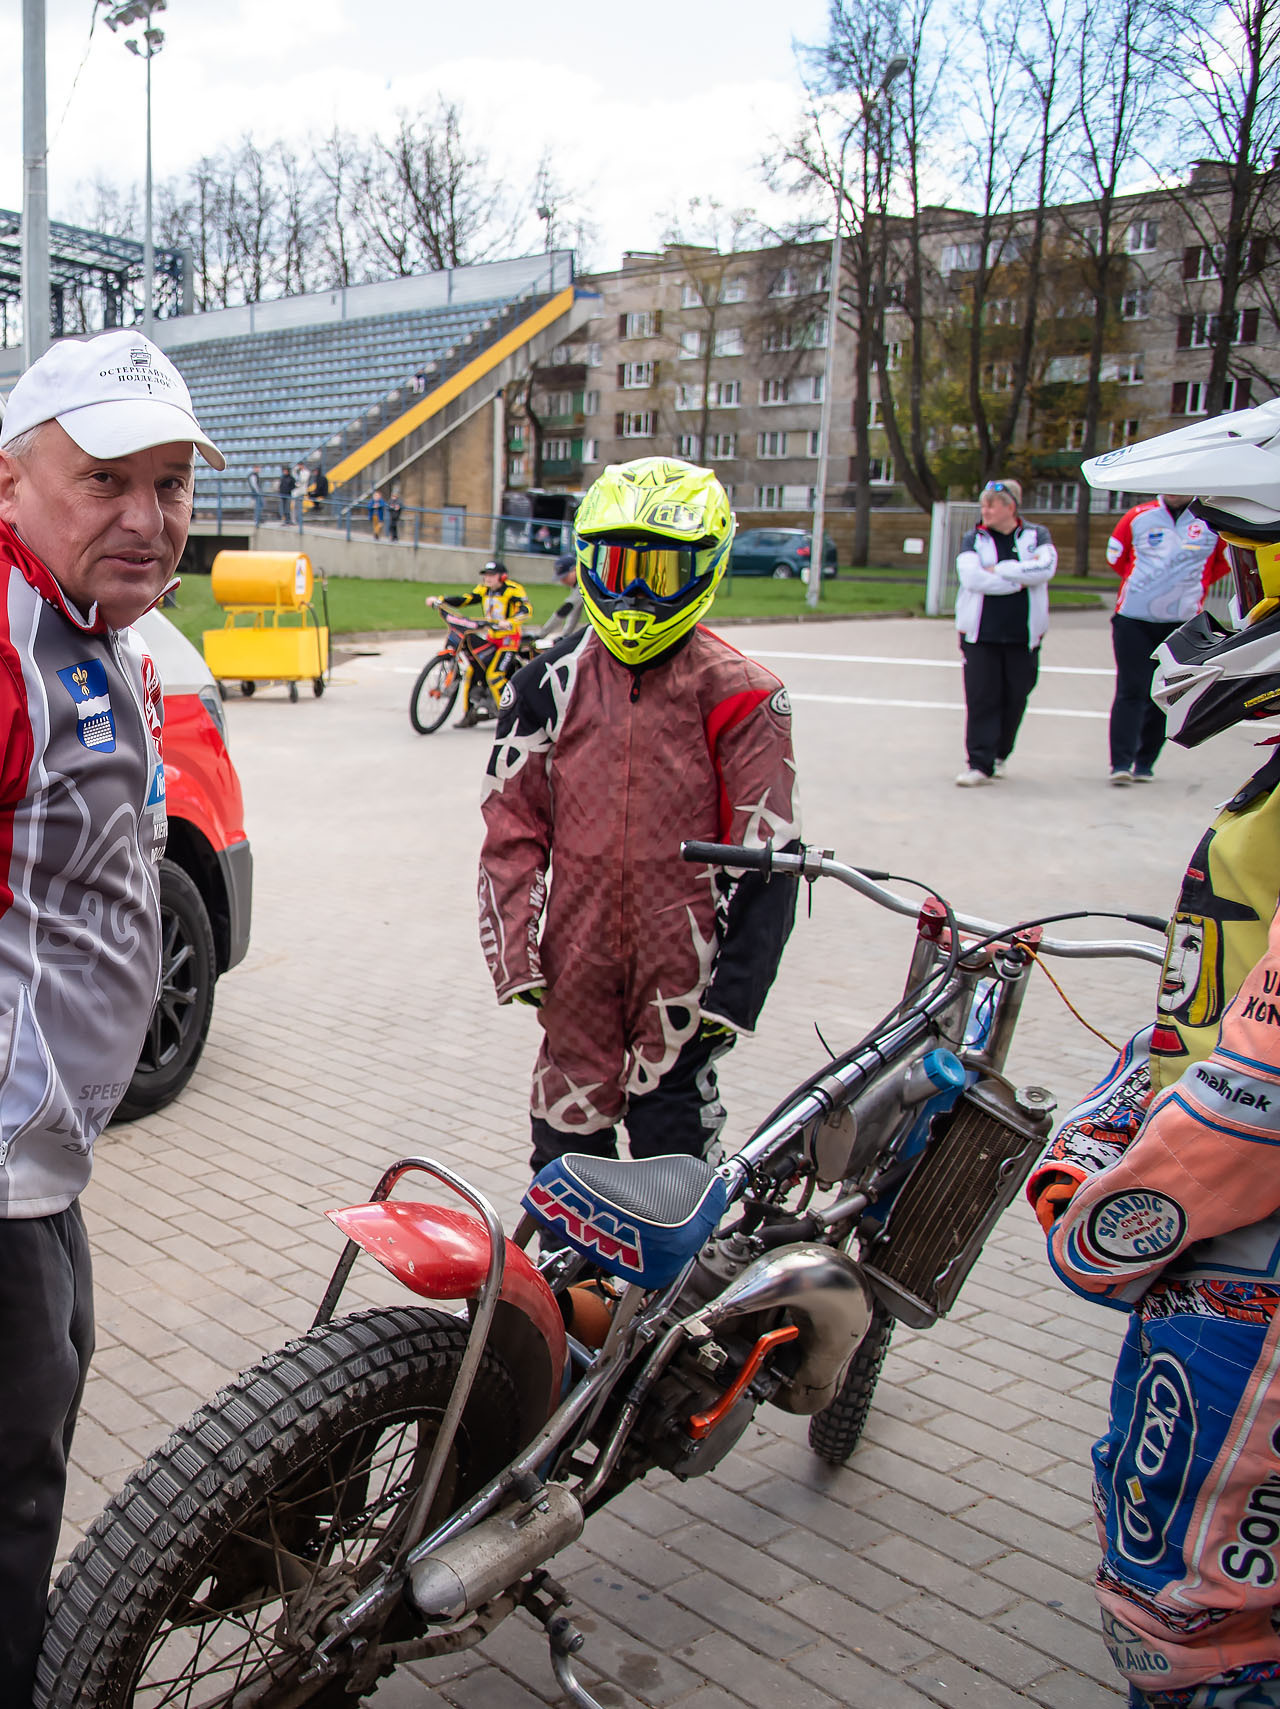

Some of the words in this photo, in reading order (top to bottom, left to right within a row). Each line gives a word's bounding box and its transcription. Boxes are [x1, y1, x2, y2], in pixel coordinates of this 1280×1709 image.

[1099, 1195, 1163, 1239] SCANDIC
[1133, 1226, 1172, 1255] CNC
[1135, 1374, 1181, 1477] CKD
[1126, 1646, 1169, 1671] Auto
